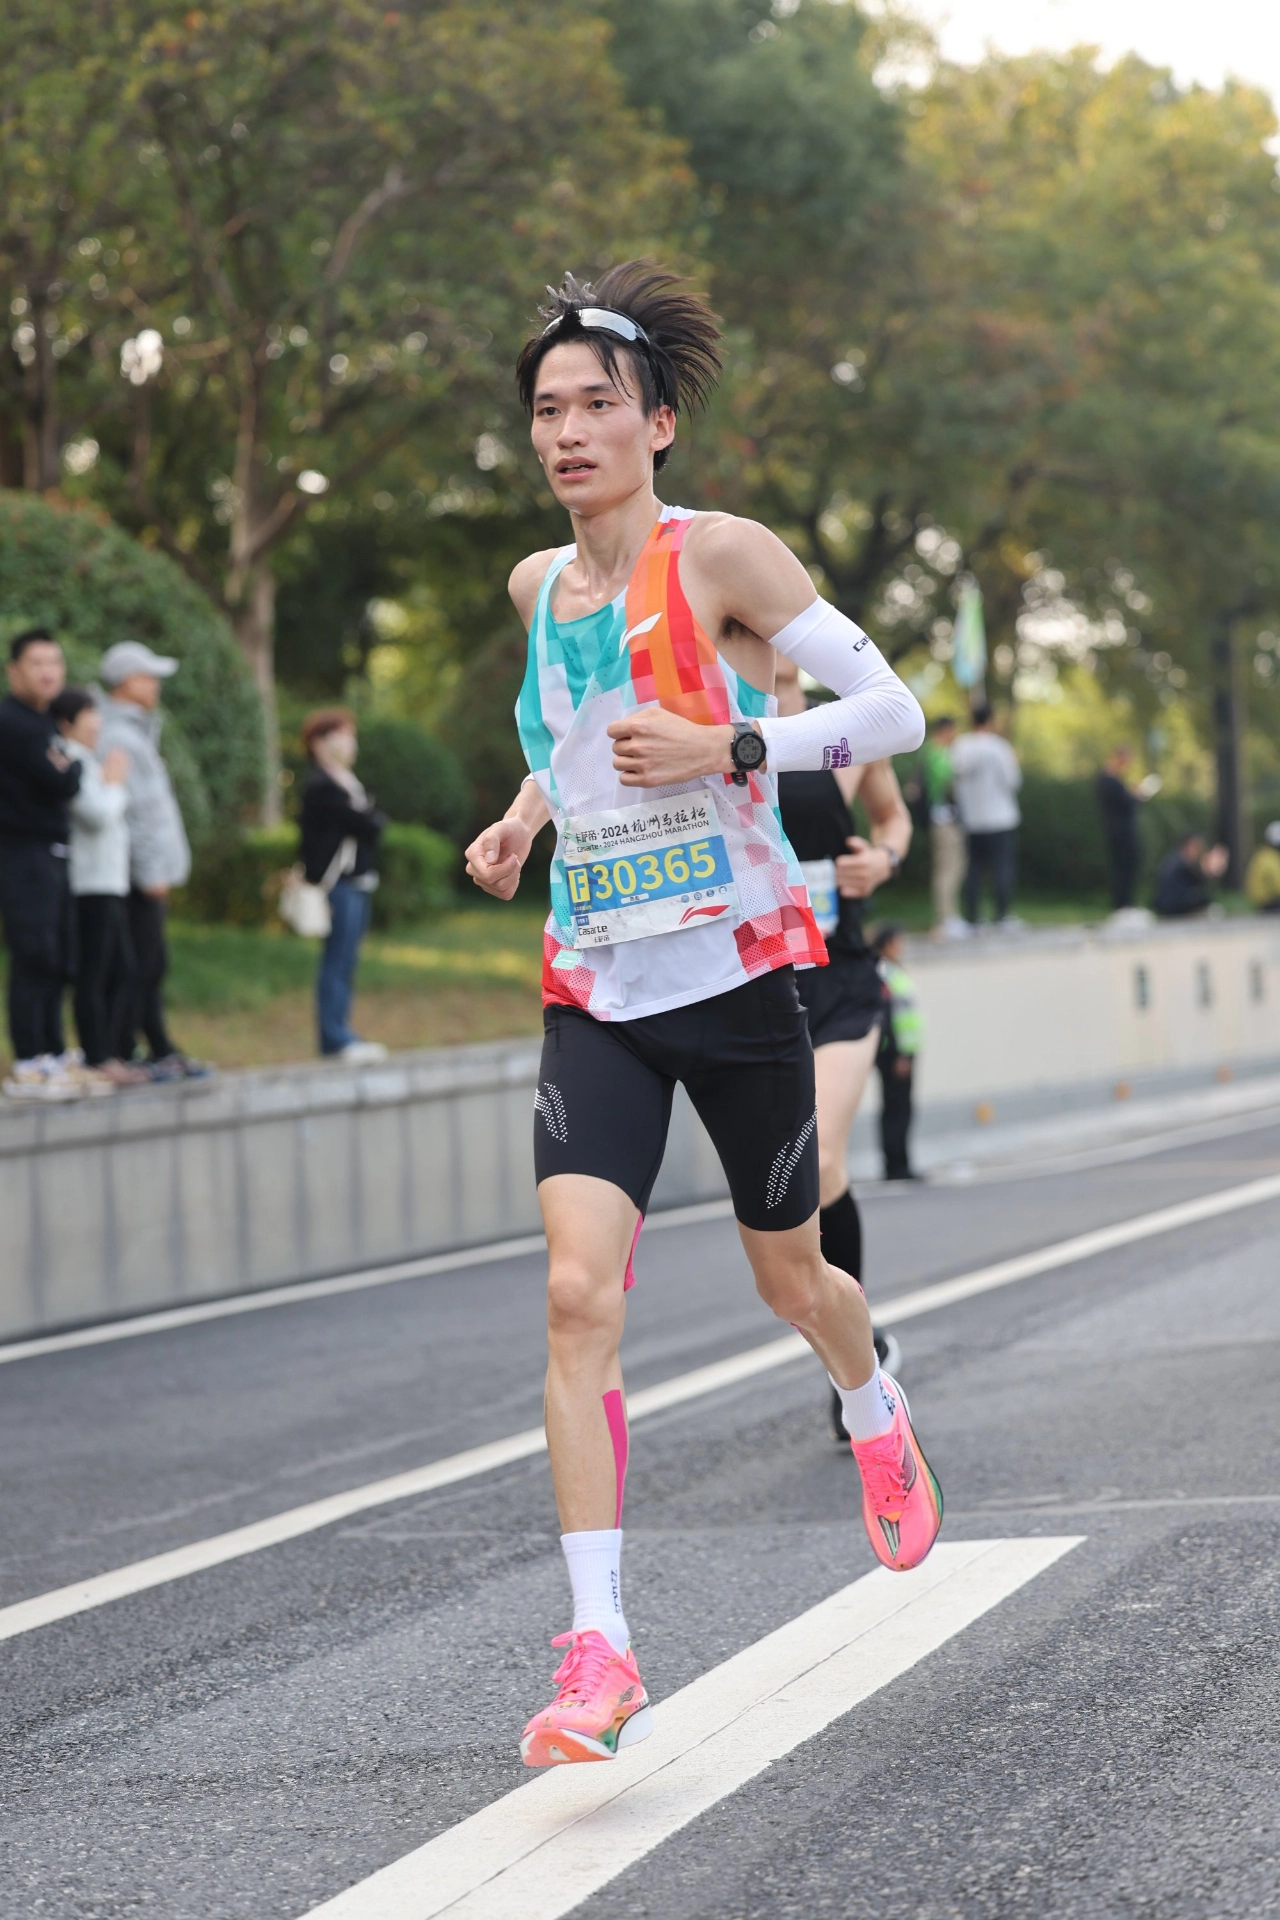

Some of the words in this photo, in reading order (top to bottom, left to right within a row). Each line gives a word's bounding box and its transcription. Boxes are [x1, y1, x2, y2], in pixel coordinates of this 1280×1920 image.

[631, 806, 706, 833] 杭州马拉松
[603, 840, 619, 848] 2024
[619, 830, 663, 845] HANGZHOU
[664, 820, 710, 835] MARATHON
[577, 925, 608, 936] Casarte
